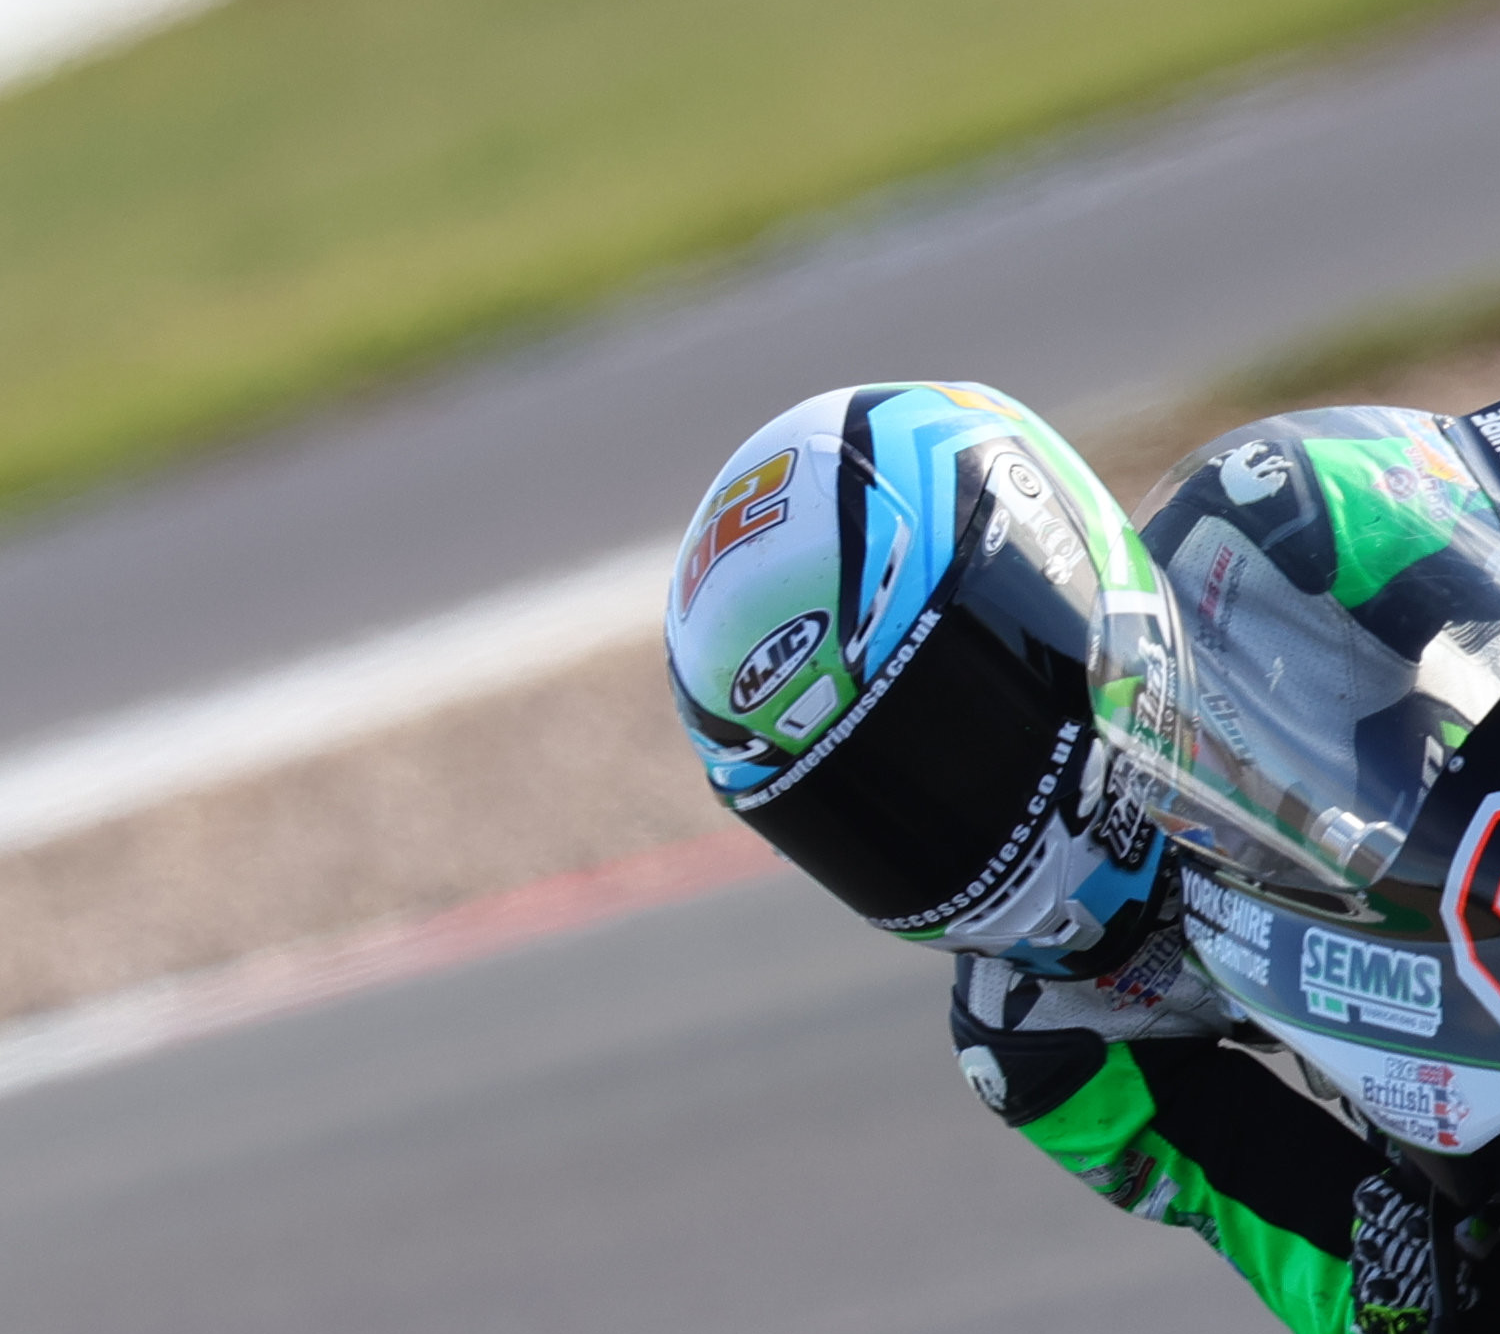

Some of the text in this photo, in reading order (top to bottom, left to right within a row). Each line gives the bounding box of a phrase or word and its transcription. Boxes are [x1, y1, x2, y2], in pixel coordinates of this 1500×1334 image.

[737, 618, 809, 703] HJC
[1181, 866, 1274, 950] YORKSHIRE
[1304, 932, 1437, 1008] SEMMS
[1362, 1075, 1431, 1115] British
